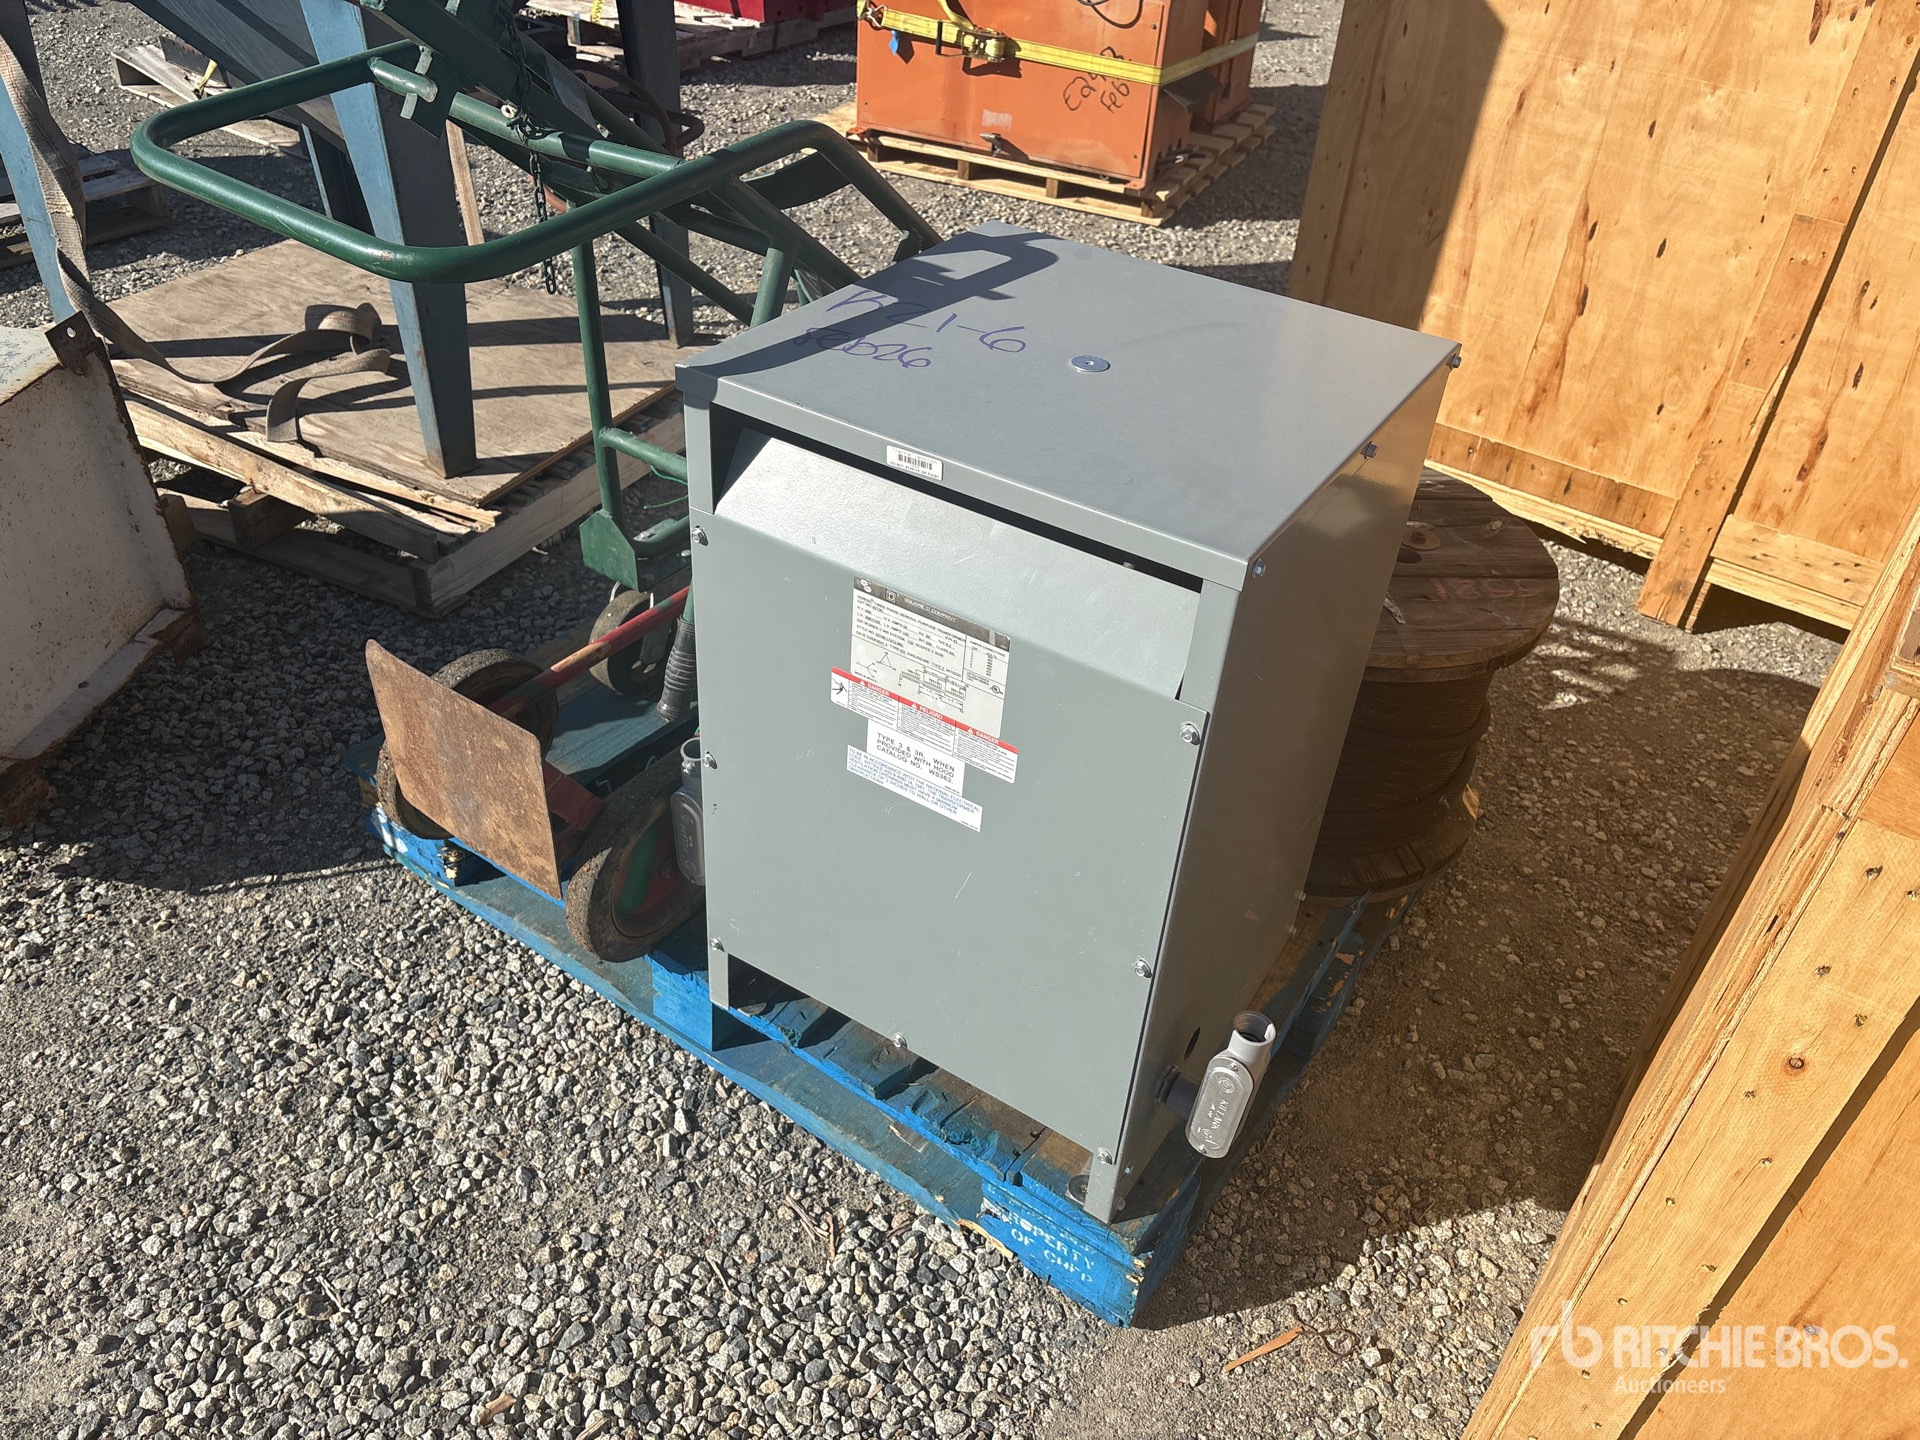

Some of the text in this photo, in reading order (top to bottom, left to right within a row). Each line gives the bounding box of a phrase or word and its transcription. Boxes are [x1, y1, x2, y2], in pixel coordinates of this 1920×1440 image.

[867, 682, 889, 696] DANGER
[919, 705, 942, 719] PELIGRO
[975, 730, 999, 744] DANGER
[876, 743, 907, 763] CATALOG
[876, 738, 954, 779] PROVIDED WITH HOOD
[877, 731, 895, 745] TYPE
[933, 757, 954, 772] WHEN
[1005, 1209, 1095, 1270] ROPERTY
[1011, 1228, 1035, 1246] OF
